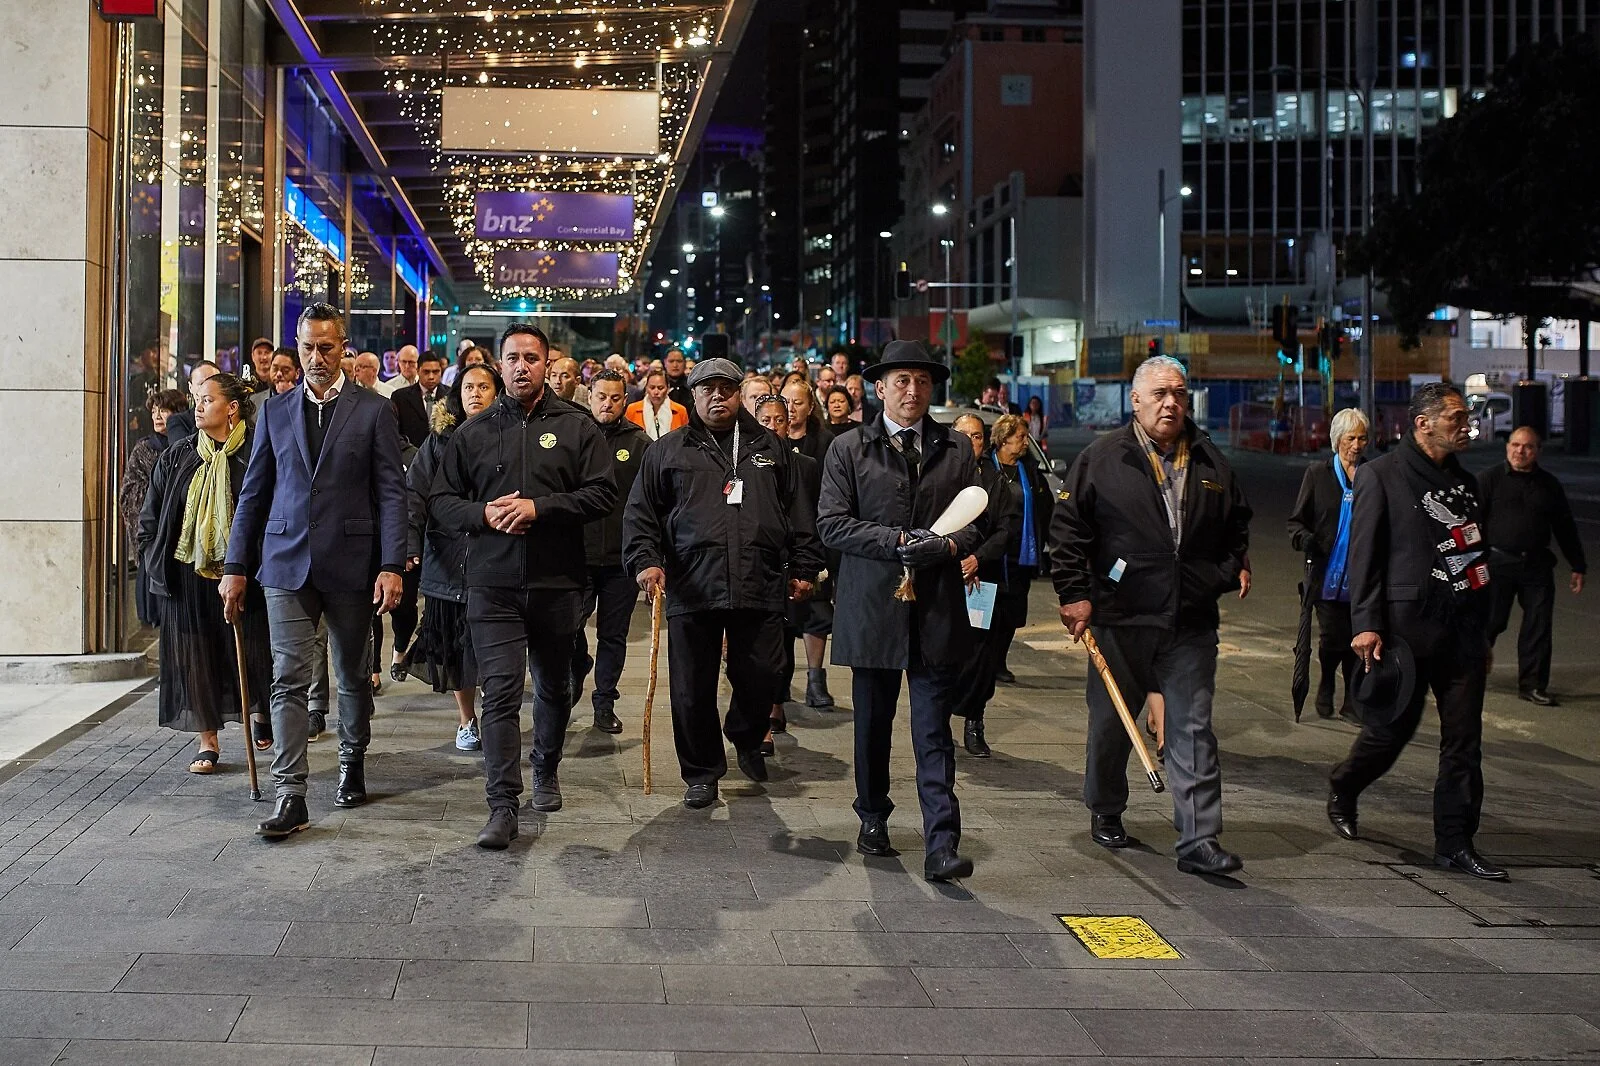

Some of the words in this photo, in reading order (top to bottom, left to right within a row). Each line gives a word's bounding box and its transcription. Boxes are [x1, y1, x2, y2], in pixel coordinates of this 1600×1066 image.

[483, 208, 534, 233] bnz
[557, 225, 608, 235] Commercial
[609, 226, 626, 237] Bay
[499, 264, 539, 283] bnz
